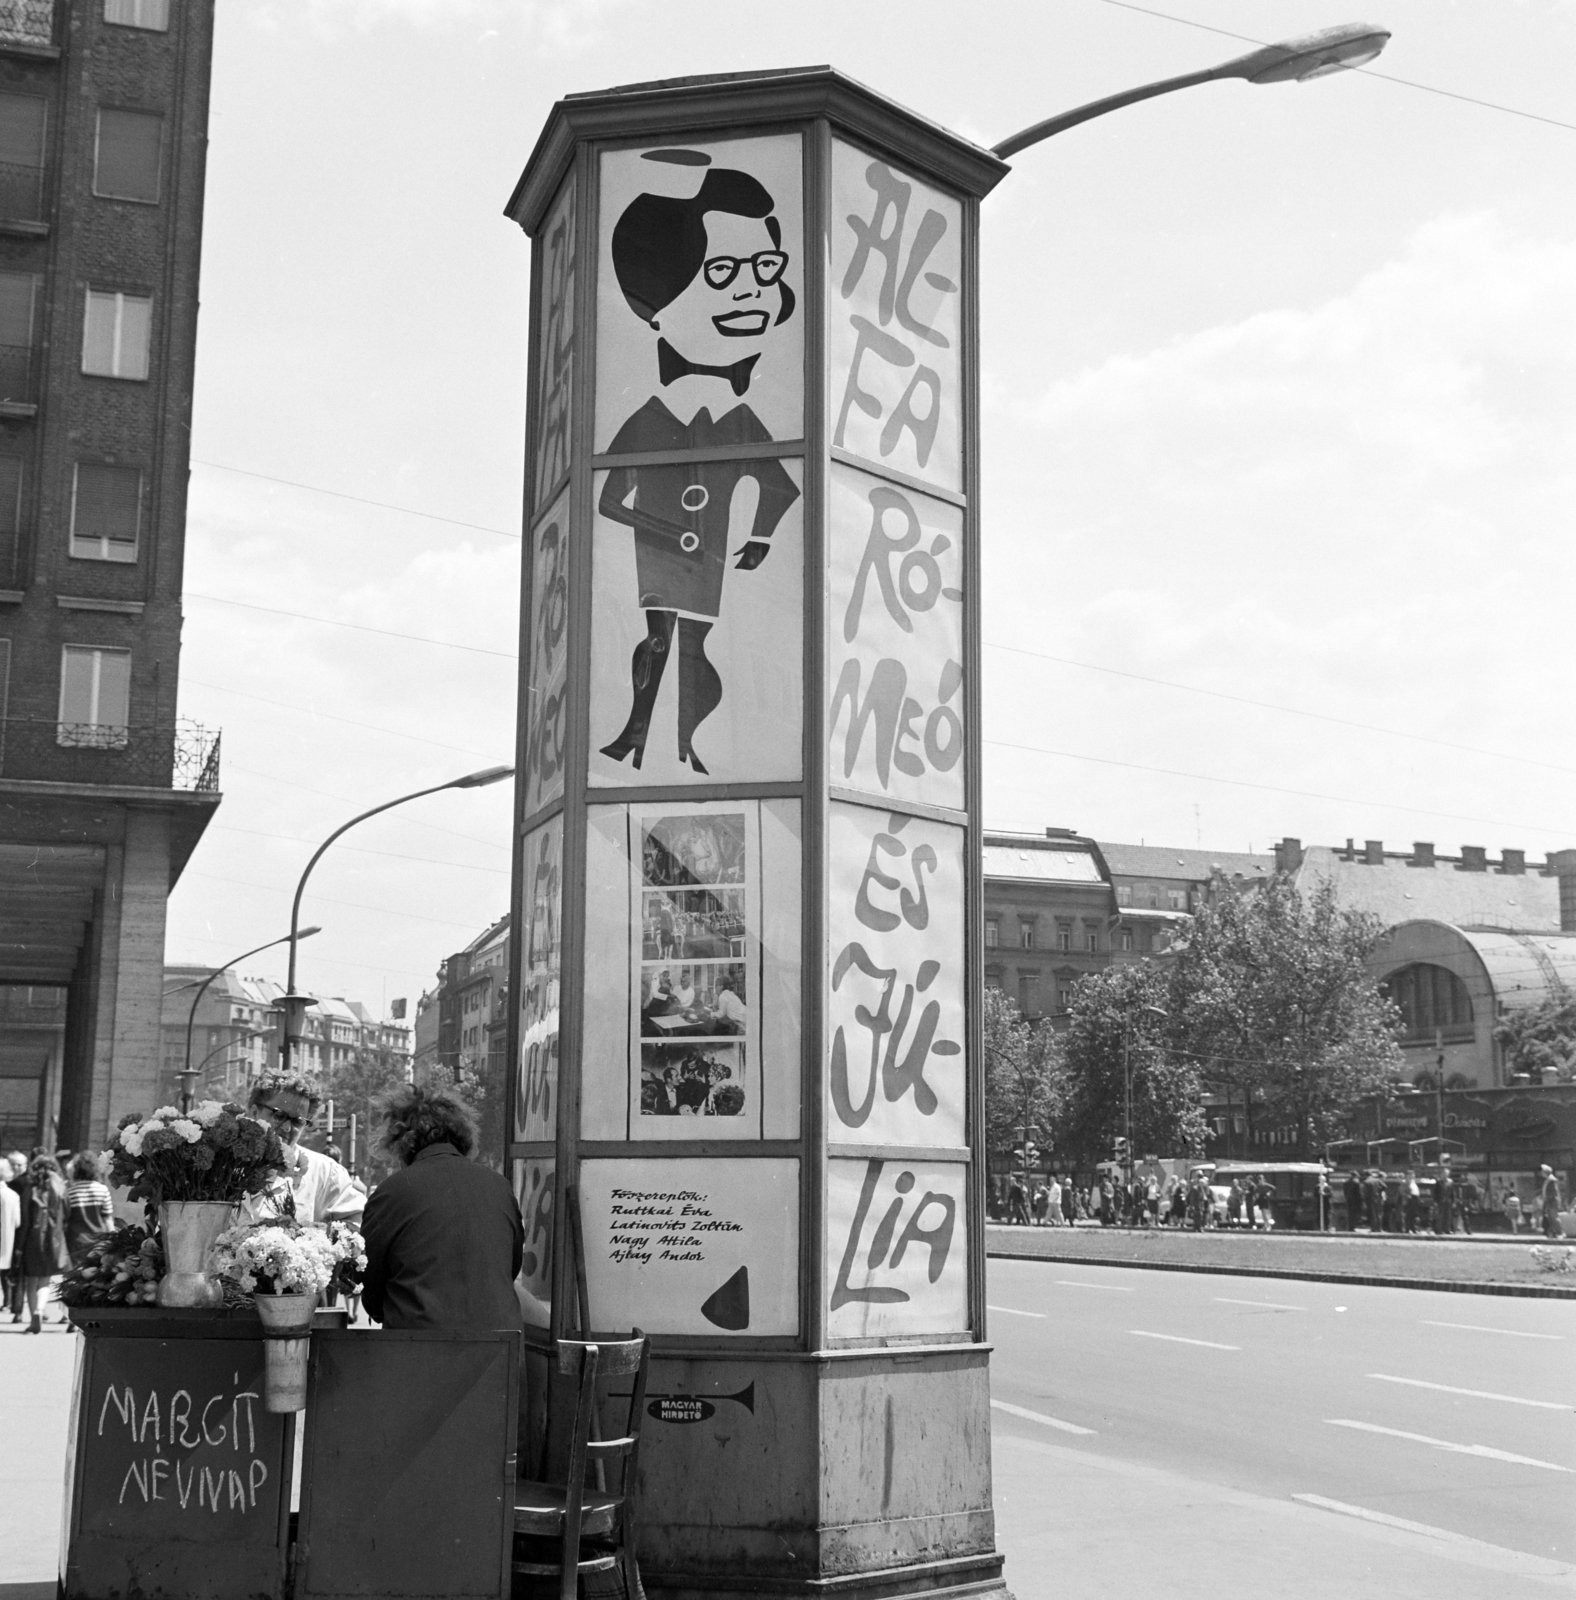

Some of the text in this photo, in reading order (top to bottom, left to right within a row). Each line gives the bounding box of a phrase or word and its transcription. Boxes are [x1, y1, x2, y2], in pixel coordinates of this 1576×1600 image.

[833, 314, 941, 468] FA
[830, 658, 962, 790] MEÓ
[855, 813, 938, 932] ÉS
[610, 1204, 712, 1217] Ruttkai Éva
[609, 1219, 743, 1232] Latinovits Zoltán
[609, 1235, 703, 1250] Nagy Attila
[609, 1250, 705, 1265] Ajtay Andor
[661, 1401, 702, 1409] MAGYAR
